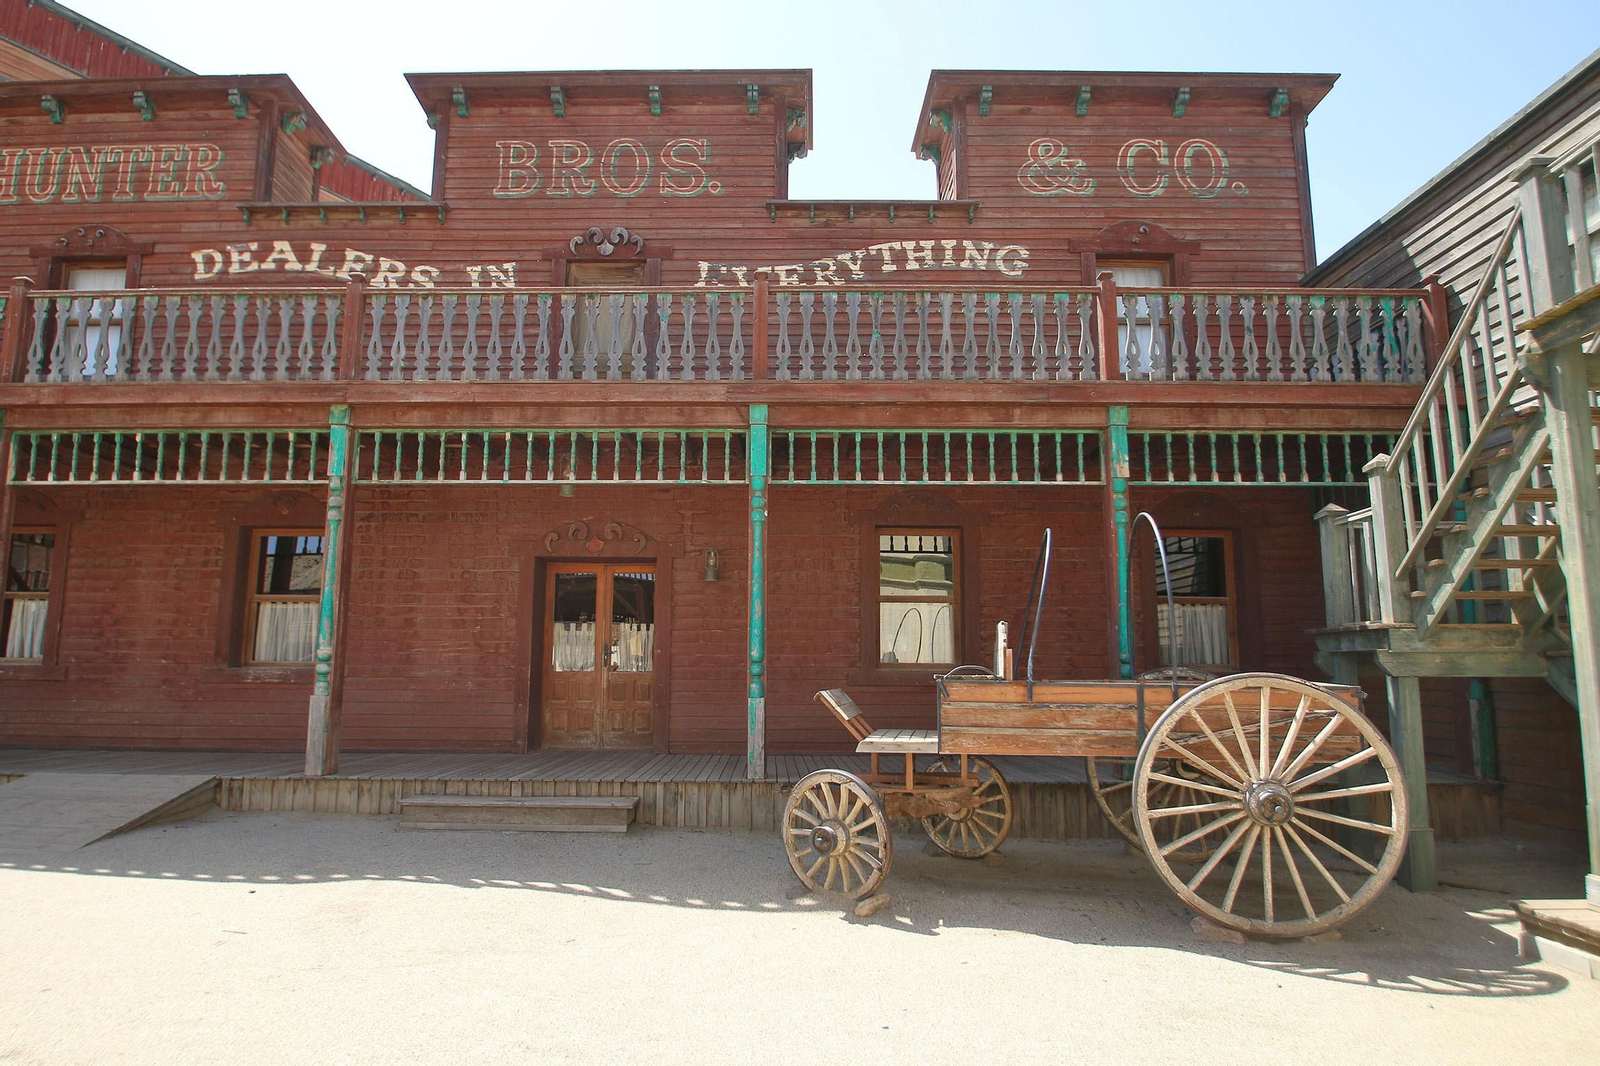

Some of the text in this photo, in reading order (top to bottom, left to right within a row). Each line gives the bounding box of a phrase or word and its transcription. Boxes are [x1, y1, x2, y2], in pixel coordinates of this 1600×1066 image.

[493, 138, 724, 198] BROS.
[1017, 138, 1097, 198] &
[1117, 138, 1249, 199] CO.
[190, 240, 441, 288] DEALERS
[465, 261, 517, 288] IN
